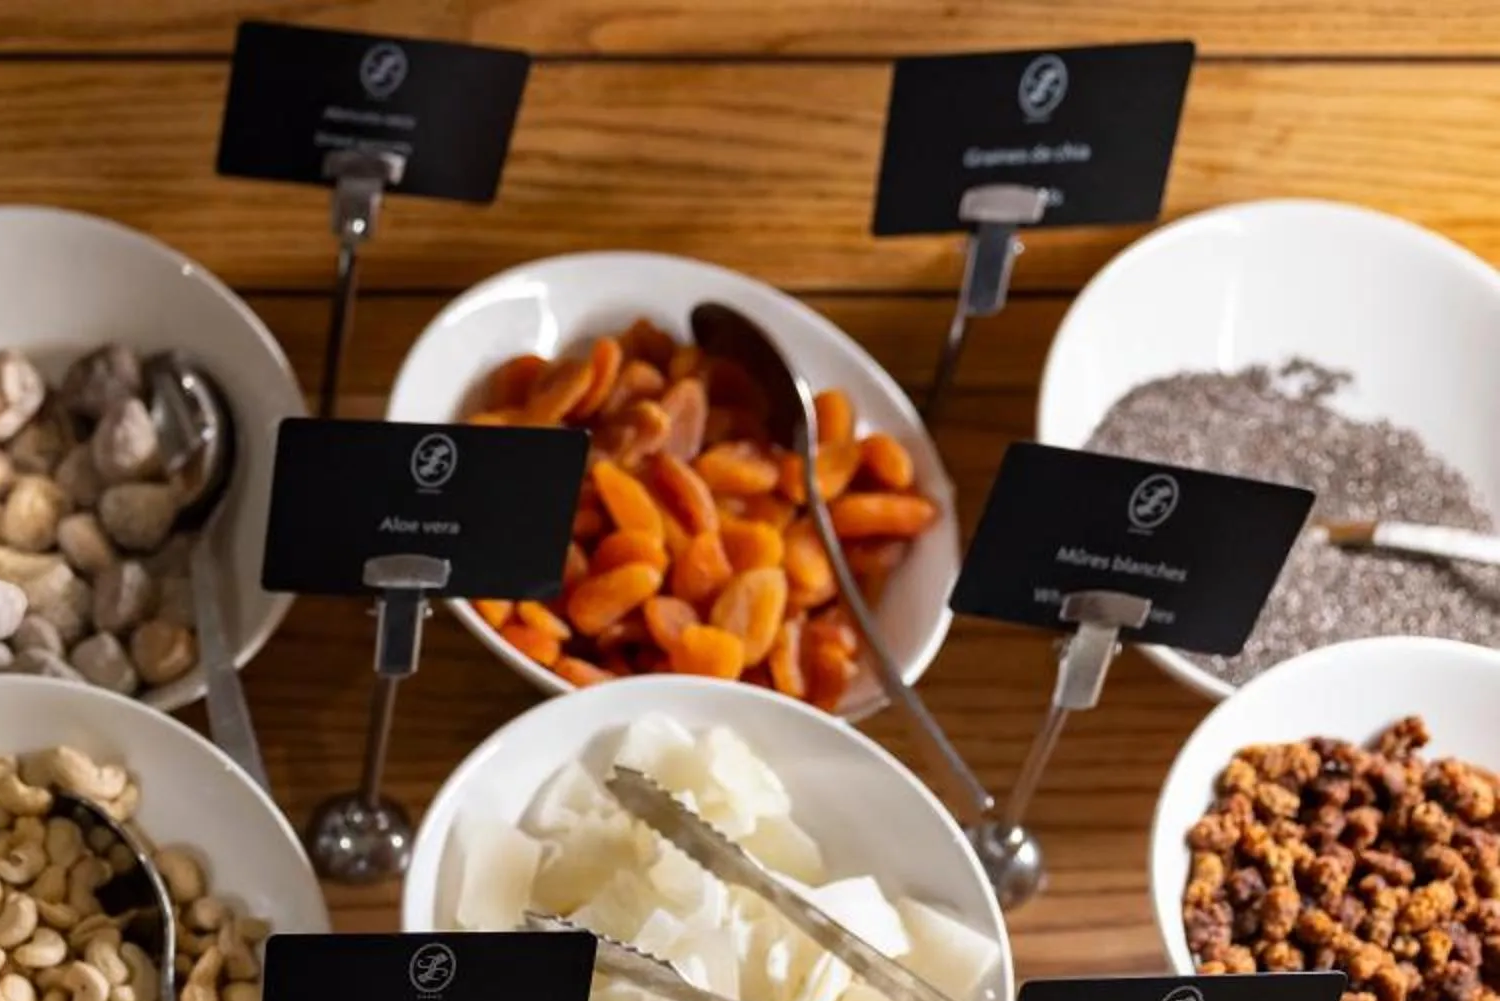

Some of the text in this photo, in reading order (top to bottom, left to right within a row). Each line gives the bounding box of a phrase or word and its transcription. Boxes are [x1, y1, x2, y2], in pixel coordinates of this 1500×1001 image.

[378, 515, 461, 535] Aloe vera
[1112, 554, 1188, 582] blanches
